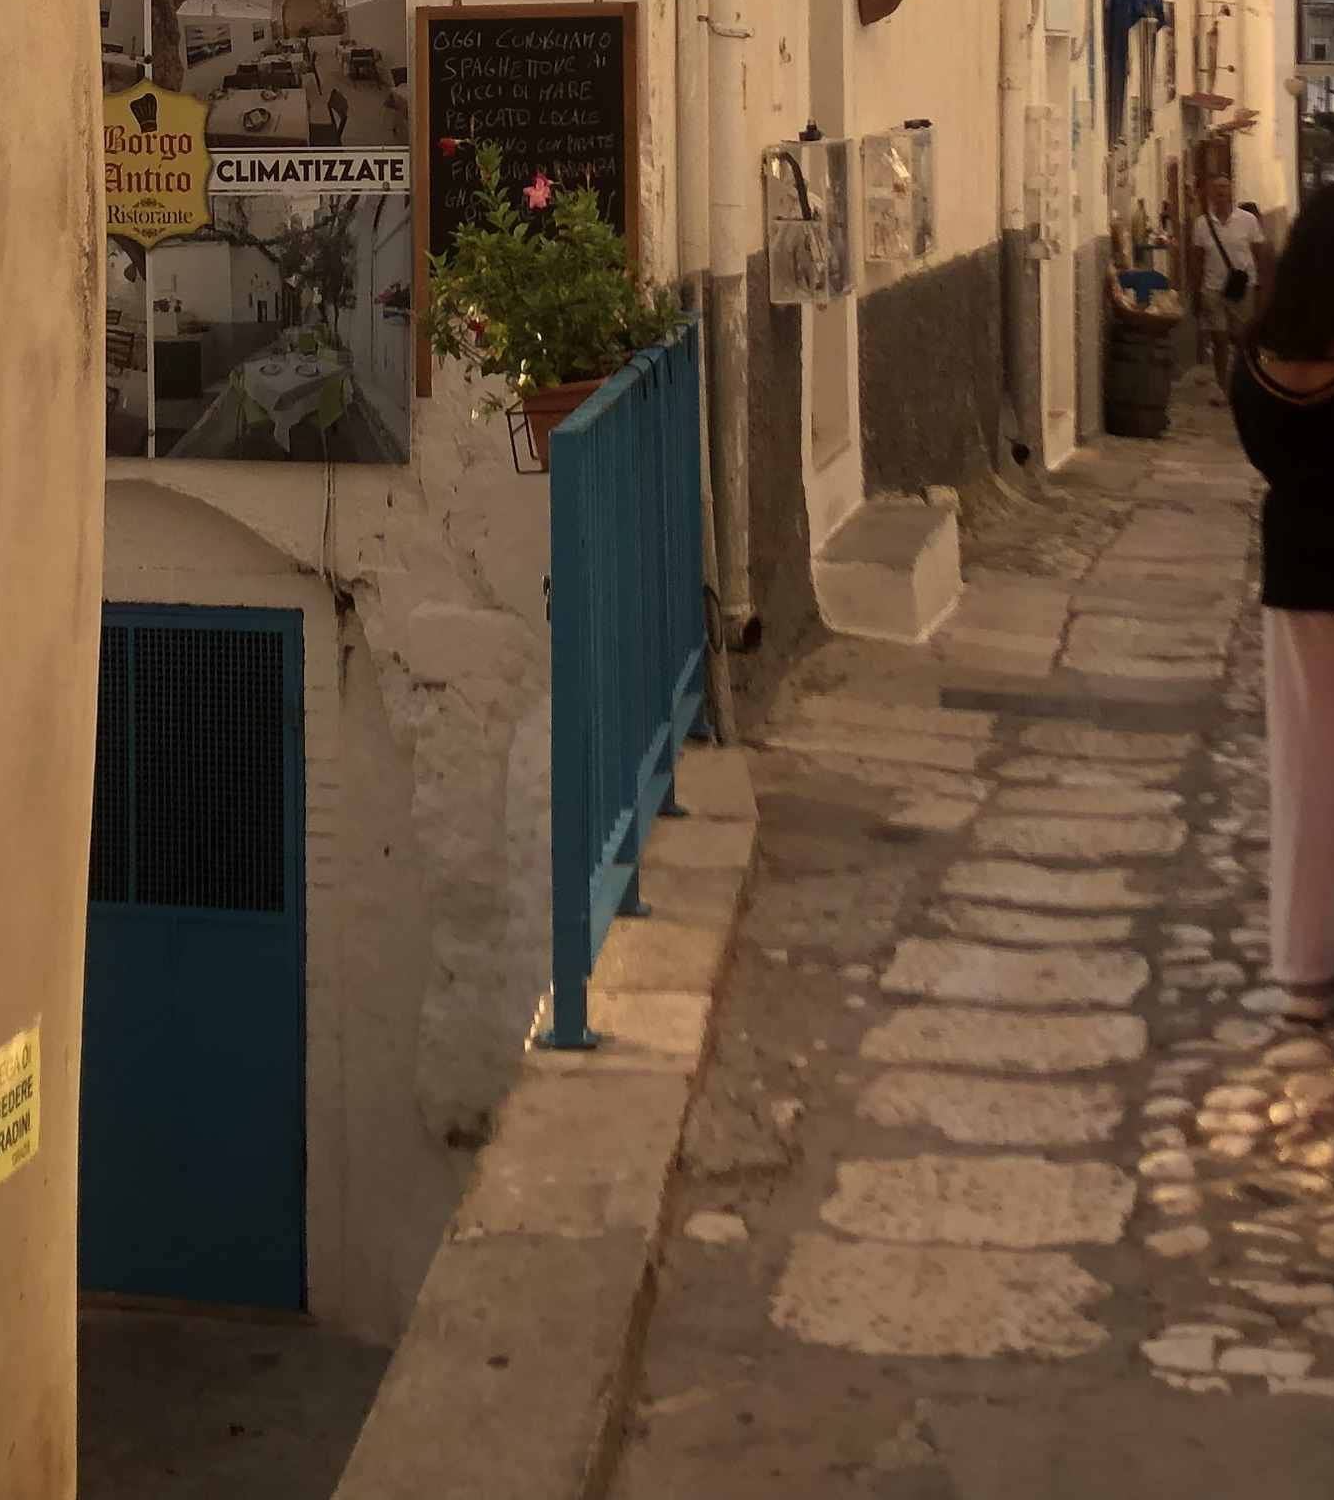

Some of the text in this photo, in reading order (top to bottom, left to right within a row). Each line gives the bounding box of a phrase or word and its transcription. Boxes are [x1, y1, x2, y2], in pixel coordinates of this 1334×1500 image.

[433, 31, 482, 51] OGGI
[441, 54, 576, 82] SPAGHETTONE
[450, 80, 593, 105] RICCI DI MARE
[445, 106, 532, 131] PESCATO
[103, 124, 193, 161] Borgo
[104, 162, 192, 194] Antico
[216, 158, 405, 183] CLIMATIZZATE
[107, 203, 194, 225] Ristorante
[22, 1043, 32, 1071] DI
